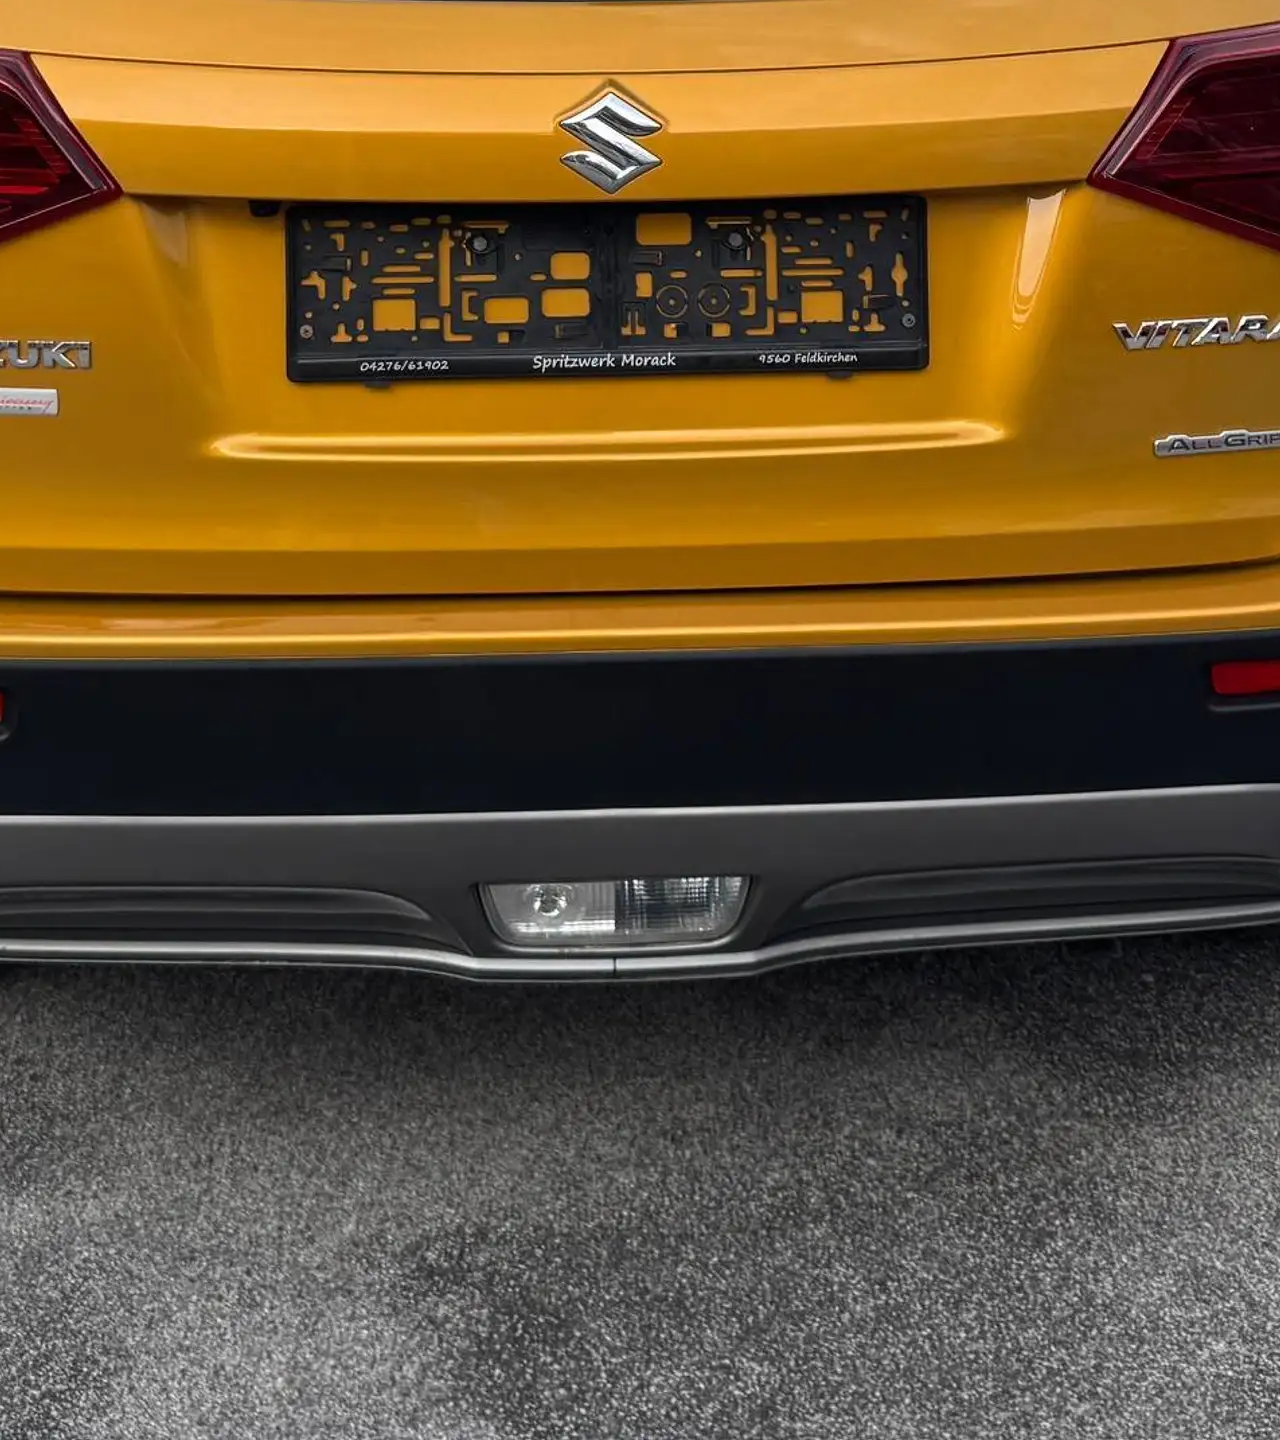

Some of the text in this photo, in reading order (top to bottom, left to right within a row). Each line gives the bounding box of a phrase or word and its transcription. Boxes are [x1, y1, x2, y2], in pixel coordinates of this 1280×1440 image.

[360, 350, 858, 374] 04276/61902 Spritzwerk Morack 9560 Feldkirchen
